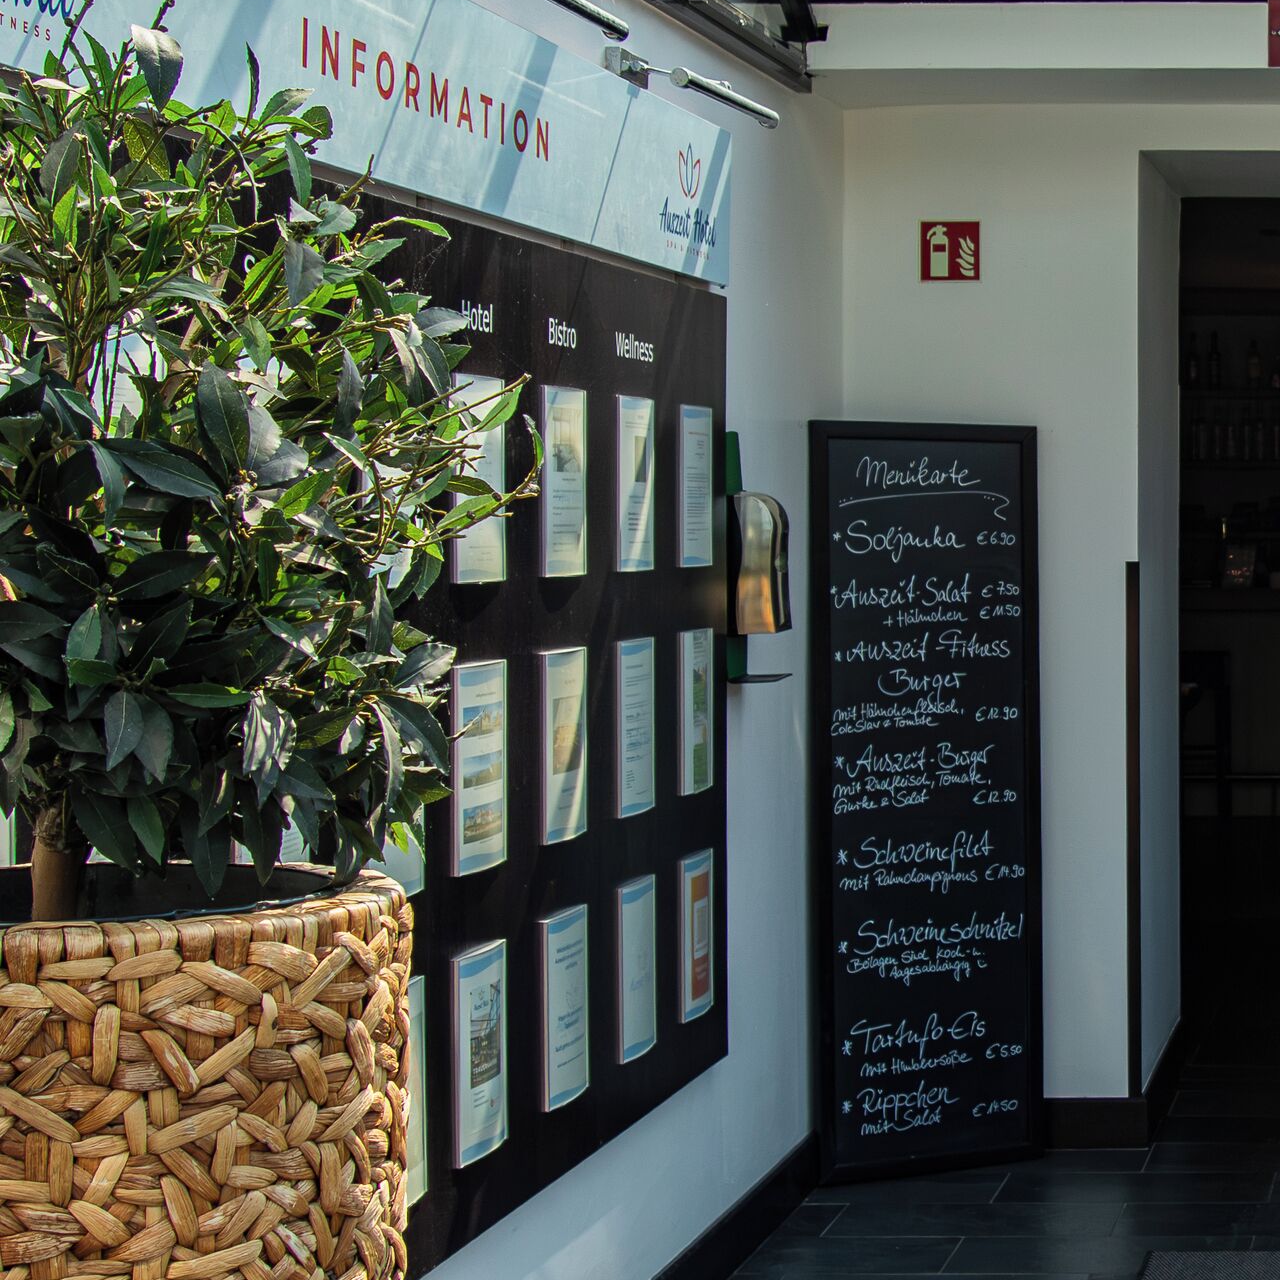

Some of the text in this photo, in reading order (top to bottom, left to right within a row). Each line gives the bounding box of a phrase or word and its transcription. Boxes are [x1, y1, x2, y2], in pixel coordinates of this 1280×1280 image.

[302, 16, 549, 162] INFORMATION
[659, 196, 716, 248] Auszeit Hotel
[461, 299, 493, 333] Hotel
[548, 318, 577, 349] Bistro
[615, 331, 654, 362] Wellness
[856, 456, 981, 489] Menükarte
[845, 520, 966, 563] Soljanka
[877, 668, 967, 707] Burger
[833, 707, 857, 722] mit
[833, 783, 861, 799] mit
[840, 875, 869, 891] mit
[860, 1062, 887, 1077] mit
[857, 1080, 960, 1120] Rippchen
[861, 1120, 892, 1136] mit
[892, 1105, 942, 1131] Salat
